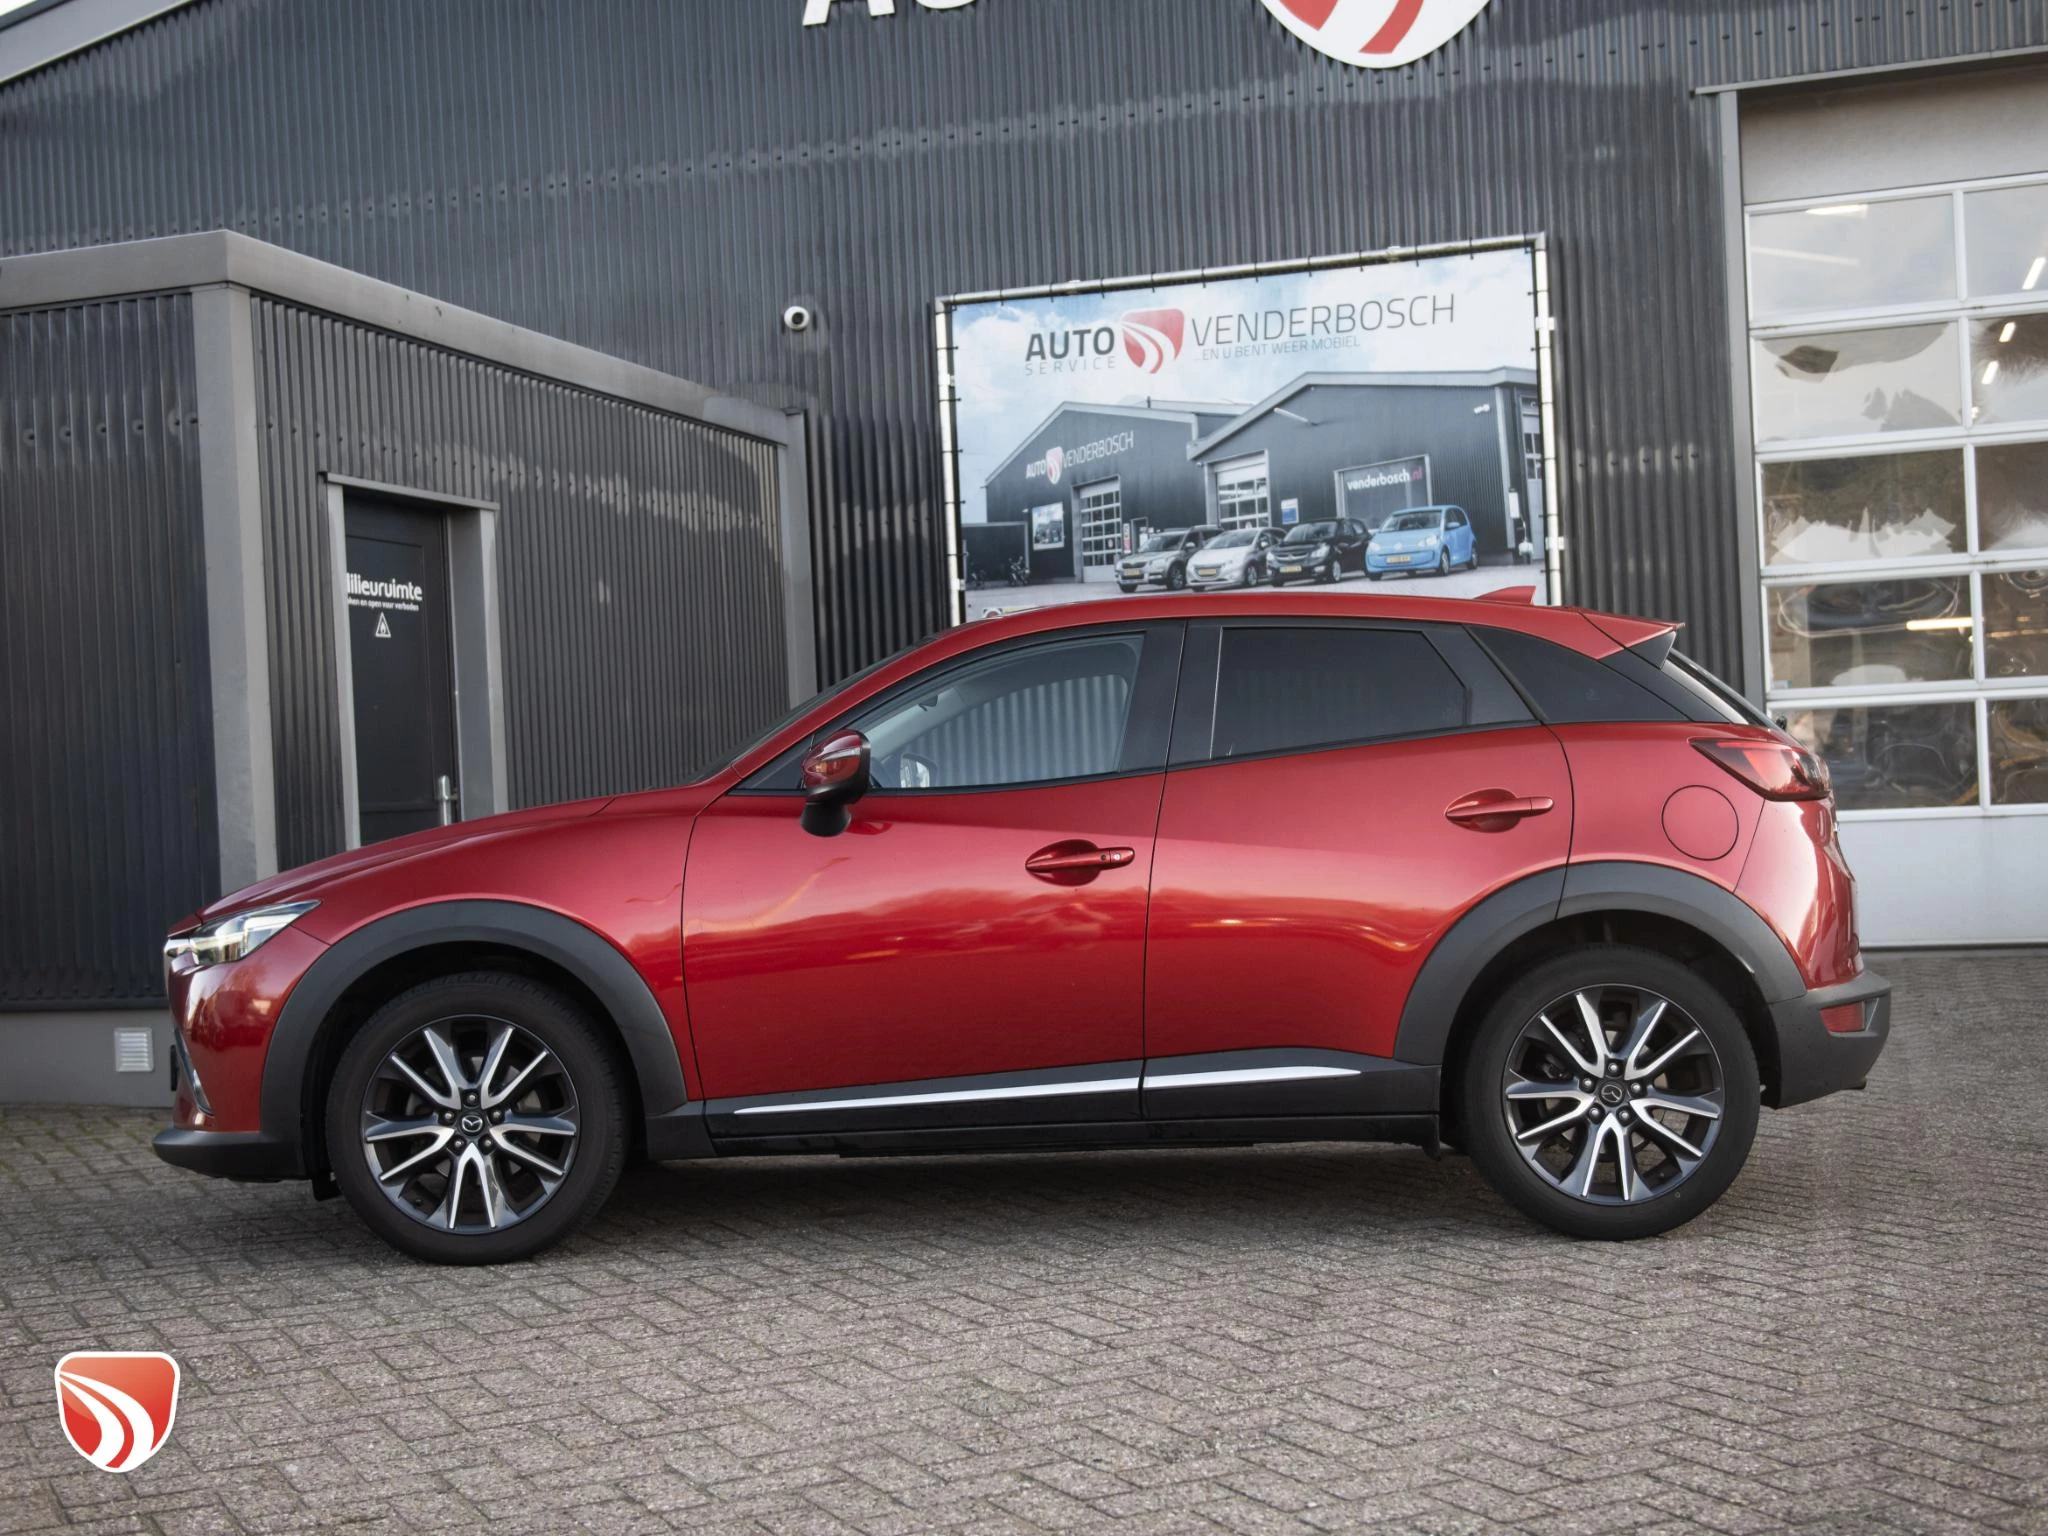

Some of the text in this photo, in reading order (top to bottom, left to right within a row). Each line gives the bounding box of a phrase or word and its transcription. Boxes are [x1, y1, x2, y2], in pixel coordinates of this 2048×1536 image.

[1025, 293, 1455, 362] AUTO VENDERBOSCH
[1222, 347, 1232, 360] U
[1234, 344, 1269, 359] BENT
[1271, 340, 1309, 355] WEER
[1311, 335, 1361, 351] MOBIEL
[1024, 355, 1116, 377] SERVICE
[1025, 429, 1135, 480] AUTO VENDERBOSCH
[1346, 466, 1423, 491] venderbosch.nl
